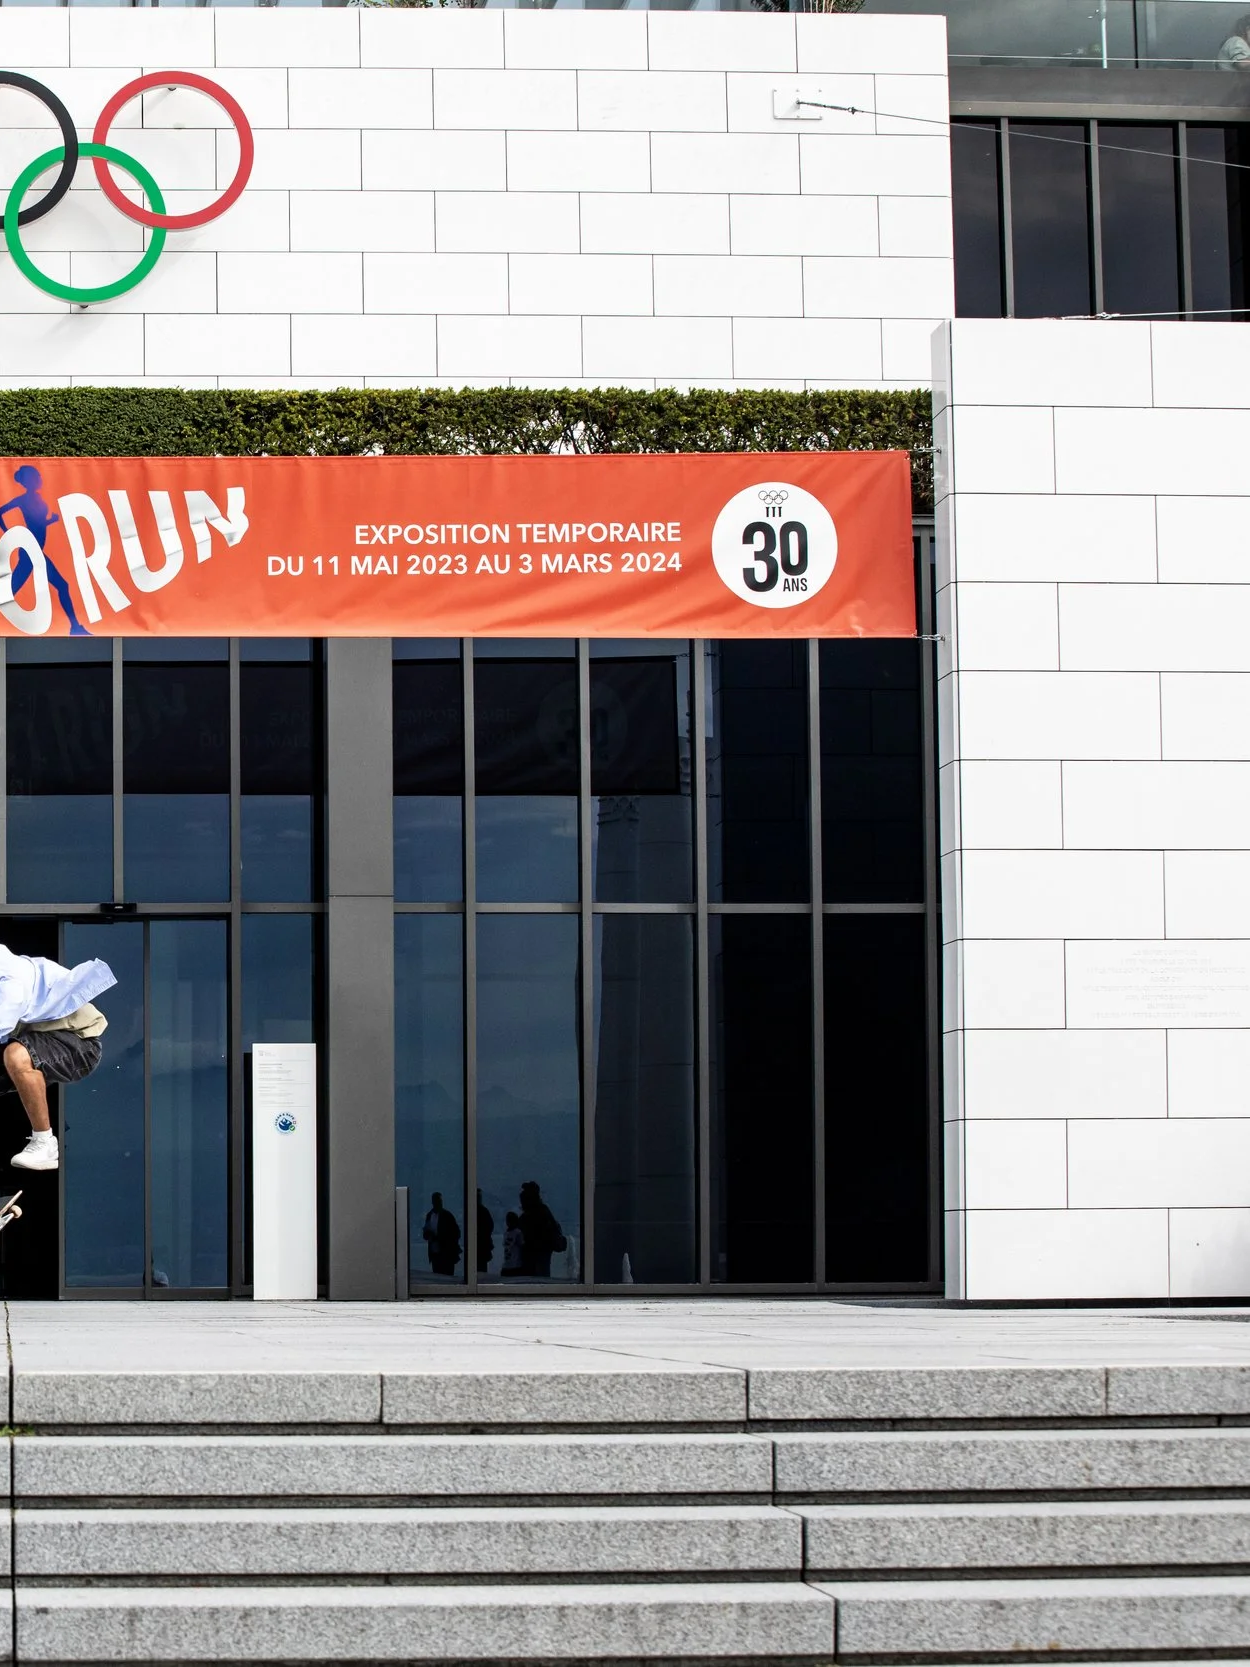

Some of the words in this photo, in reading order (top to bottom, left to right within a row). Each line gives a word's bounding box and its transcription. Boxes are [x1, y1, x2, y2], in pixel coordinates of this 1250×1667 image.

[355, 524, 510, 545] EXPOSITION
[516, 522, 682, 543] TEMPORAIRE
[57, 486, 250, 624] RUN
[267, 556, 304, 576] DU
[313, 555, 339, 576] 11
[351, 555, 398, 575] MAI
[406, 554, 468, 575] 2023
[475, 554, 511, 575] AU
[518, 553, 533, 574] 3
[541, 553, 613, 574] MARS
[620, 552, 682, 573] 2024
[742, 520, 808, 593] 30
[782, 578, 808, 592] ANS
